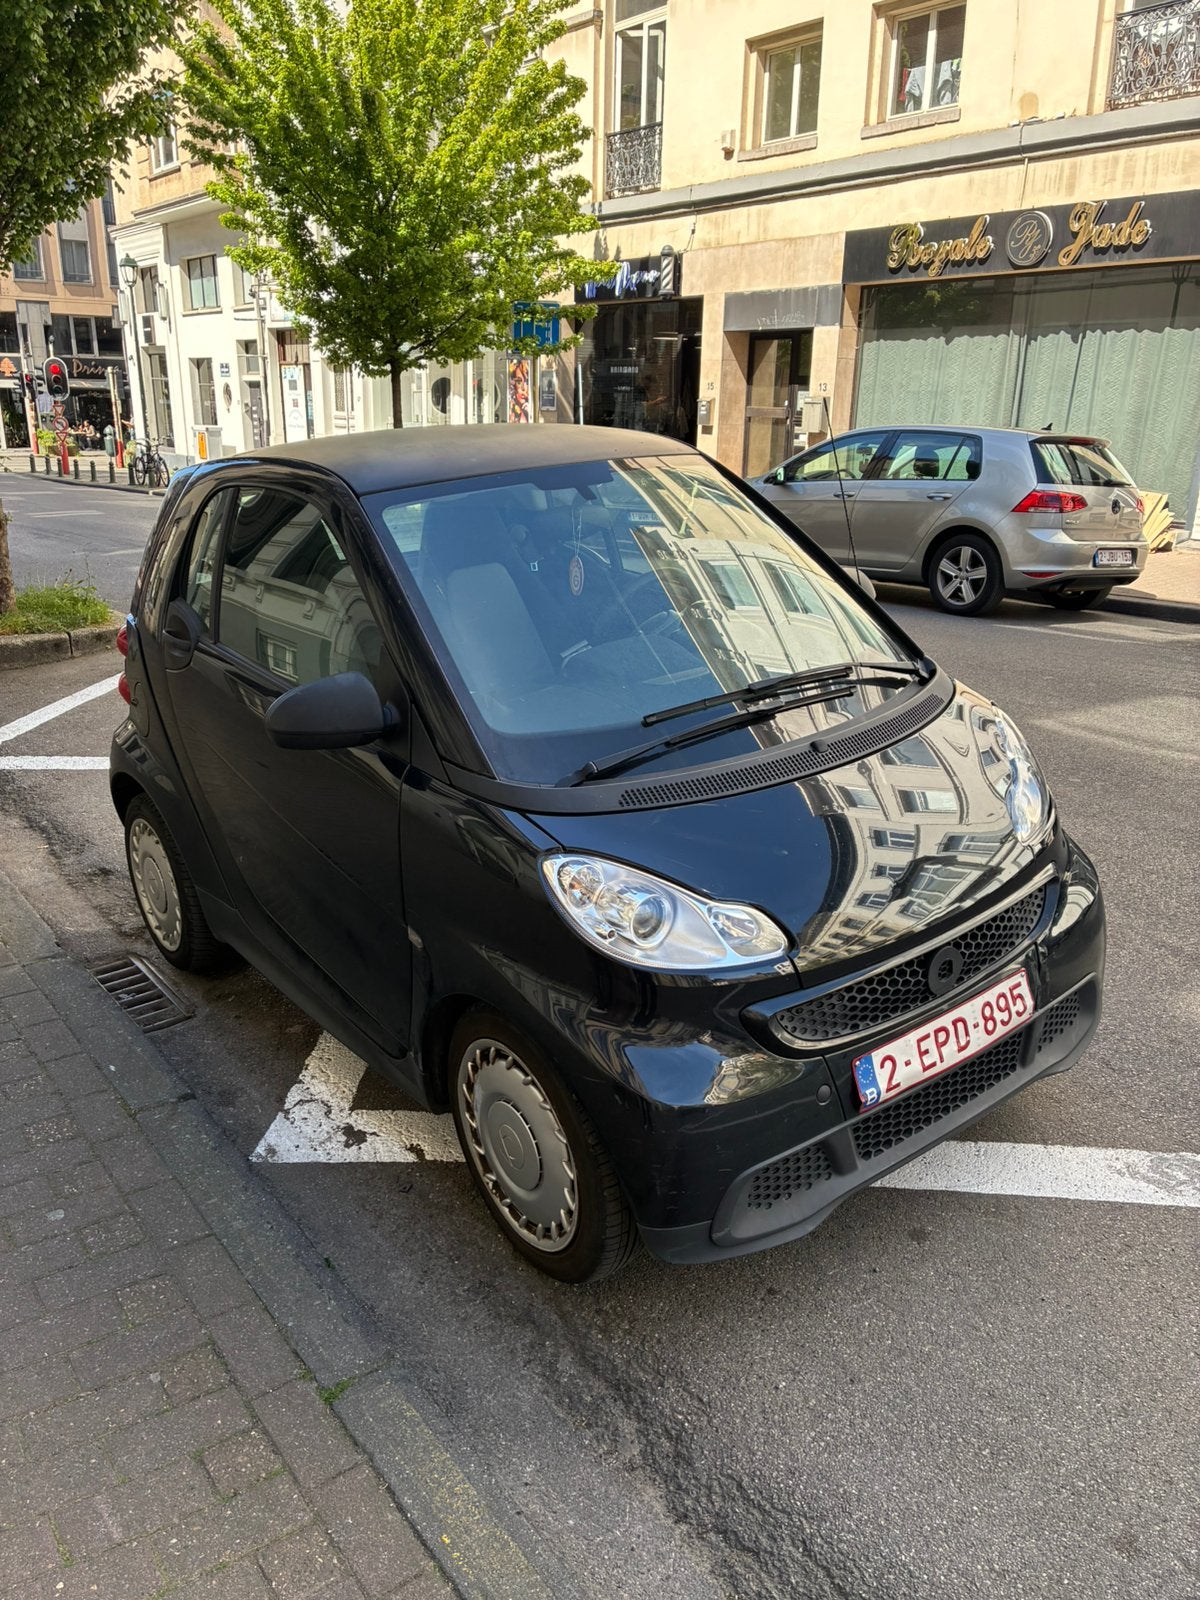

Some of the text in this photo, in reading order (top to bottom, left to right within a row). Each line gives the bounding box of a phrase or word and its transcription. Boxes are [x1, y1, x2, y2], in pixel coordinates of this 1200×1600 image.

[886, 214, 995, 277] Royale
[1058, 200, 1152, 267] Jade
[707, 382, 715, 390] 15
[819, 383, 828, 392] 13
[879, 981, 1028, 1094] 2-EPD-895
[865, 1087, 878, 1105] B
